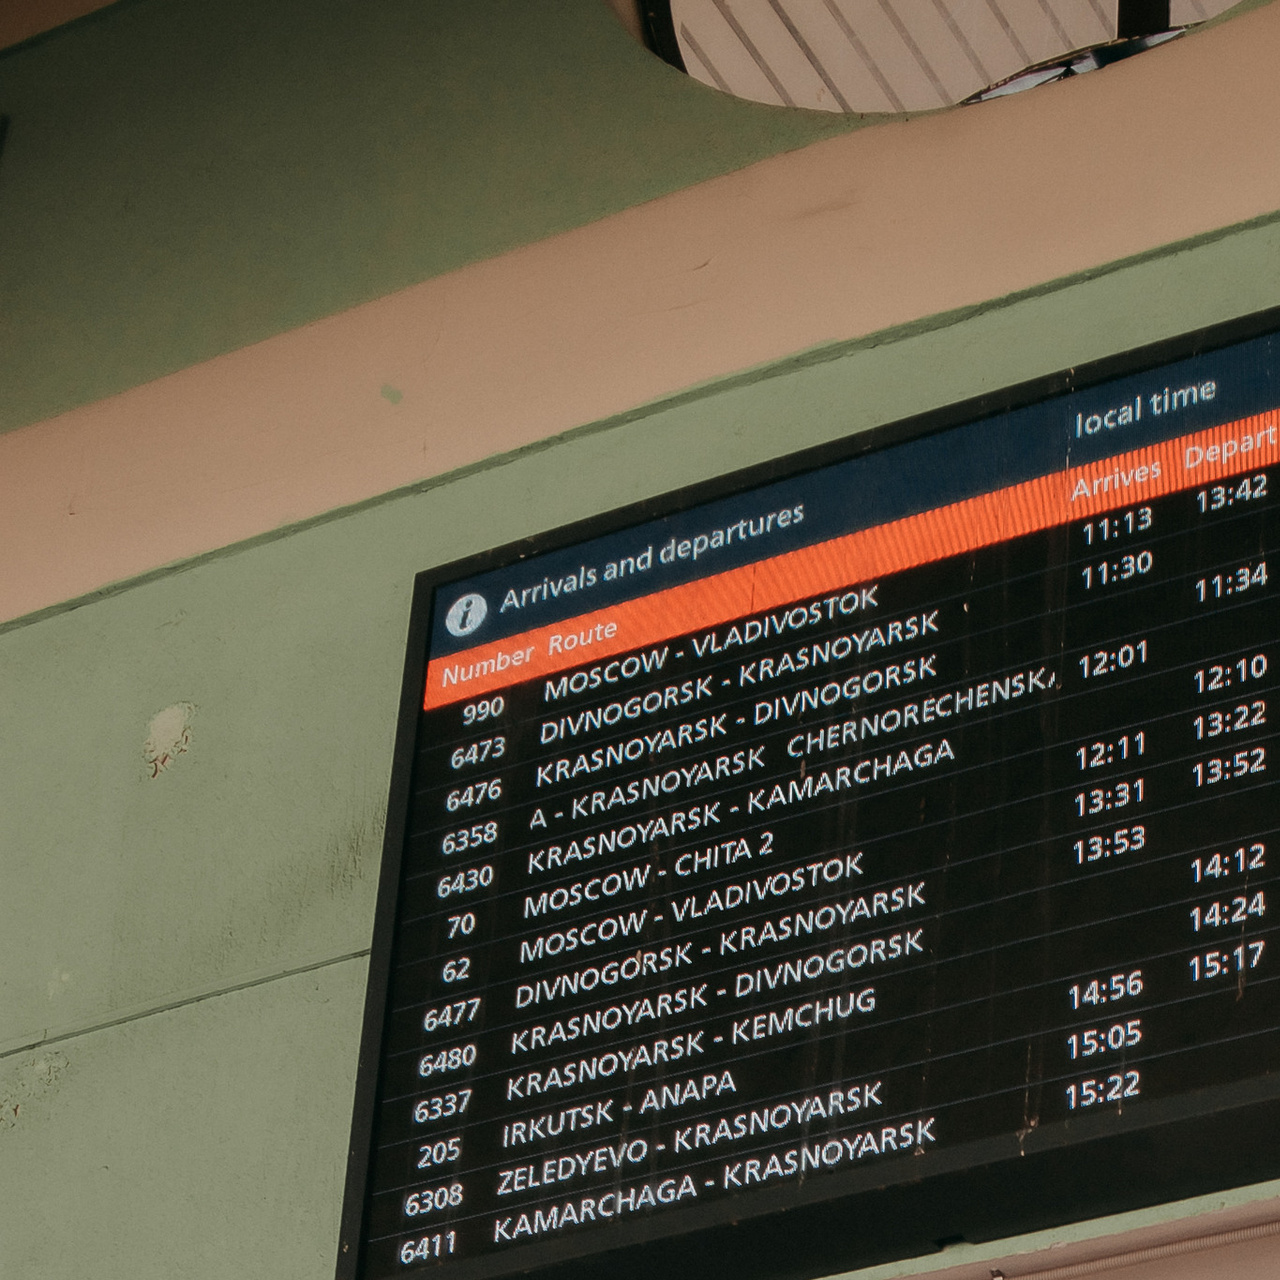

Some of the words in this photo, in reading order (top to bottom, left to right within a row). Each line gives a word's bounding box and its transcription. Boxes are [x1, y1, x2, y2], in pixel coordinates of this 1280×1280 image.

[1075, 396, 1142, 438] local
[1150, 380, 1217, 415] time
[442, 646, 535, 688] Number
[548, 622, 617, 656] Route
[1071, 459, 1162, 502] Arrives
[1184, 425, 1278, 470] Depart
[451, 737, 505, 770] 6473
[541, 675, 712, 744] DIVNOGORSK
[740, 610, 938, 687] KRASNOYARSK
[1082, 551, 1153, 590] 11:30
[463, 696, 504, 726] 990
[545, 646, 669, 702] MOSCOW
[692, 585, 878, 658] VLADIVOSTOK
[1083, 507, 1153, 546] 11:13
[1197, 474, 1268, 513] 13:42
[500, 565, 597, 613] Arrivals
[603, 546, 652, 583] and
[659, 504, 804, 563] departures
[437, 865, 494, 898] 6430
[528, 802, 720, 874] KRASNOYARSK
[748, 739, 955, 814] KAMARCHAGA
[1194, 654, 1268, 694] 12:10
[442, 821, 498, 855] 6358
[529, 808, 548, 831] A
[572, 745, 765, 819] KRASNOYARSK
[1079, 640, 1147, 679] 12:01
[447, 778, 502, 812] 6476
[537, 713, 726, 787] KRASNOYARSK
[755, 654, 936, 725] DIVNOGORSK
[1196, 562, 1269, 602] 11:34
[423, 998, 481, 1032] 6477
[515, 942, 692, 1008] DIVNOGORSK
[720, 882, 925, 955] KRASNOYARSK
[1074, 826, 1146, 865] 13:53
[443, 957, 471, 983] 62
[520, 909, 648, 963] MOSCOW
[671, 852, 863, 922] VLADIVOSTOK
[1075, 779, 1145, 817] 13:31
[1193, 748, 1267, 788] 13:52
[448, 913, 476, 939] 70
[524, 864, 651, 918] MOSCOW
[675, 838, 753, 876] CHITA
[759, 831, 774, 856] 2
[1076, 732, 1146, 771] 12:11
[1194, 701, 1267, 740] 13:22
[412, 1089, 473, 1123] 6337
[507, 1030, 704, 1101] KRASNOYARSK
[732, 988, 876, 1046] KEMCHUG
[1190, 892, 1266, 932] 14:24
[417, 1137, 462, 1169] 205
[503, 1099, 614, 1147] IRKUTSK
[638, 1071, 737, 1115] ANAPA
[1069, 970, 1144, 1010] 14:56
[1189, 941, 1266, 982] 15:17
[418, 1044, 477, 1078] 6480
[511, 983, 708, 1054] KRASNOYARSK
[735, 928, 923, 998] DIVNOGORSK
[1191, 844, 1266, 883] 14:12
[399, 1230, 457, 1262] 6411
[494, 1175, 698, 1242] KAMARCHAGA
[723, 1117, 936, 1189] KRASNOYARSK
[1066, 1071, 1141, 1110] 15:22
[404, 1183, 463, 1217] 6308
[497, 1139, 648, 1195] ZELEDYEVO
[674, 1081, 882, 1153] KRASNOYARSK
[1068, 1019, 1143, 1060] 15:05
